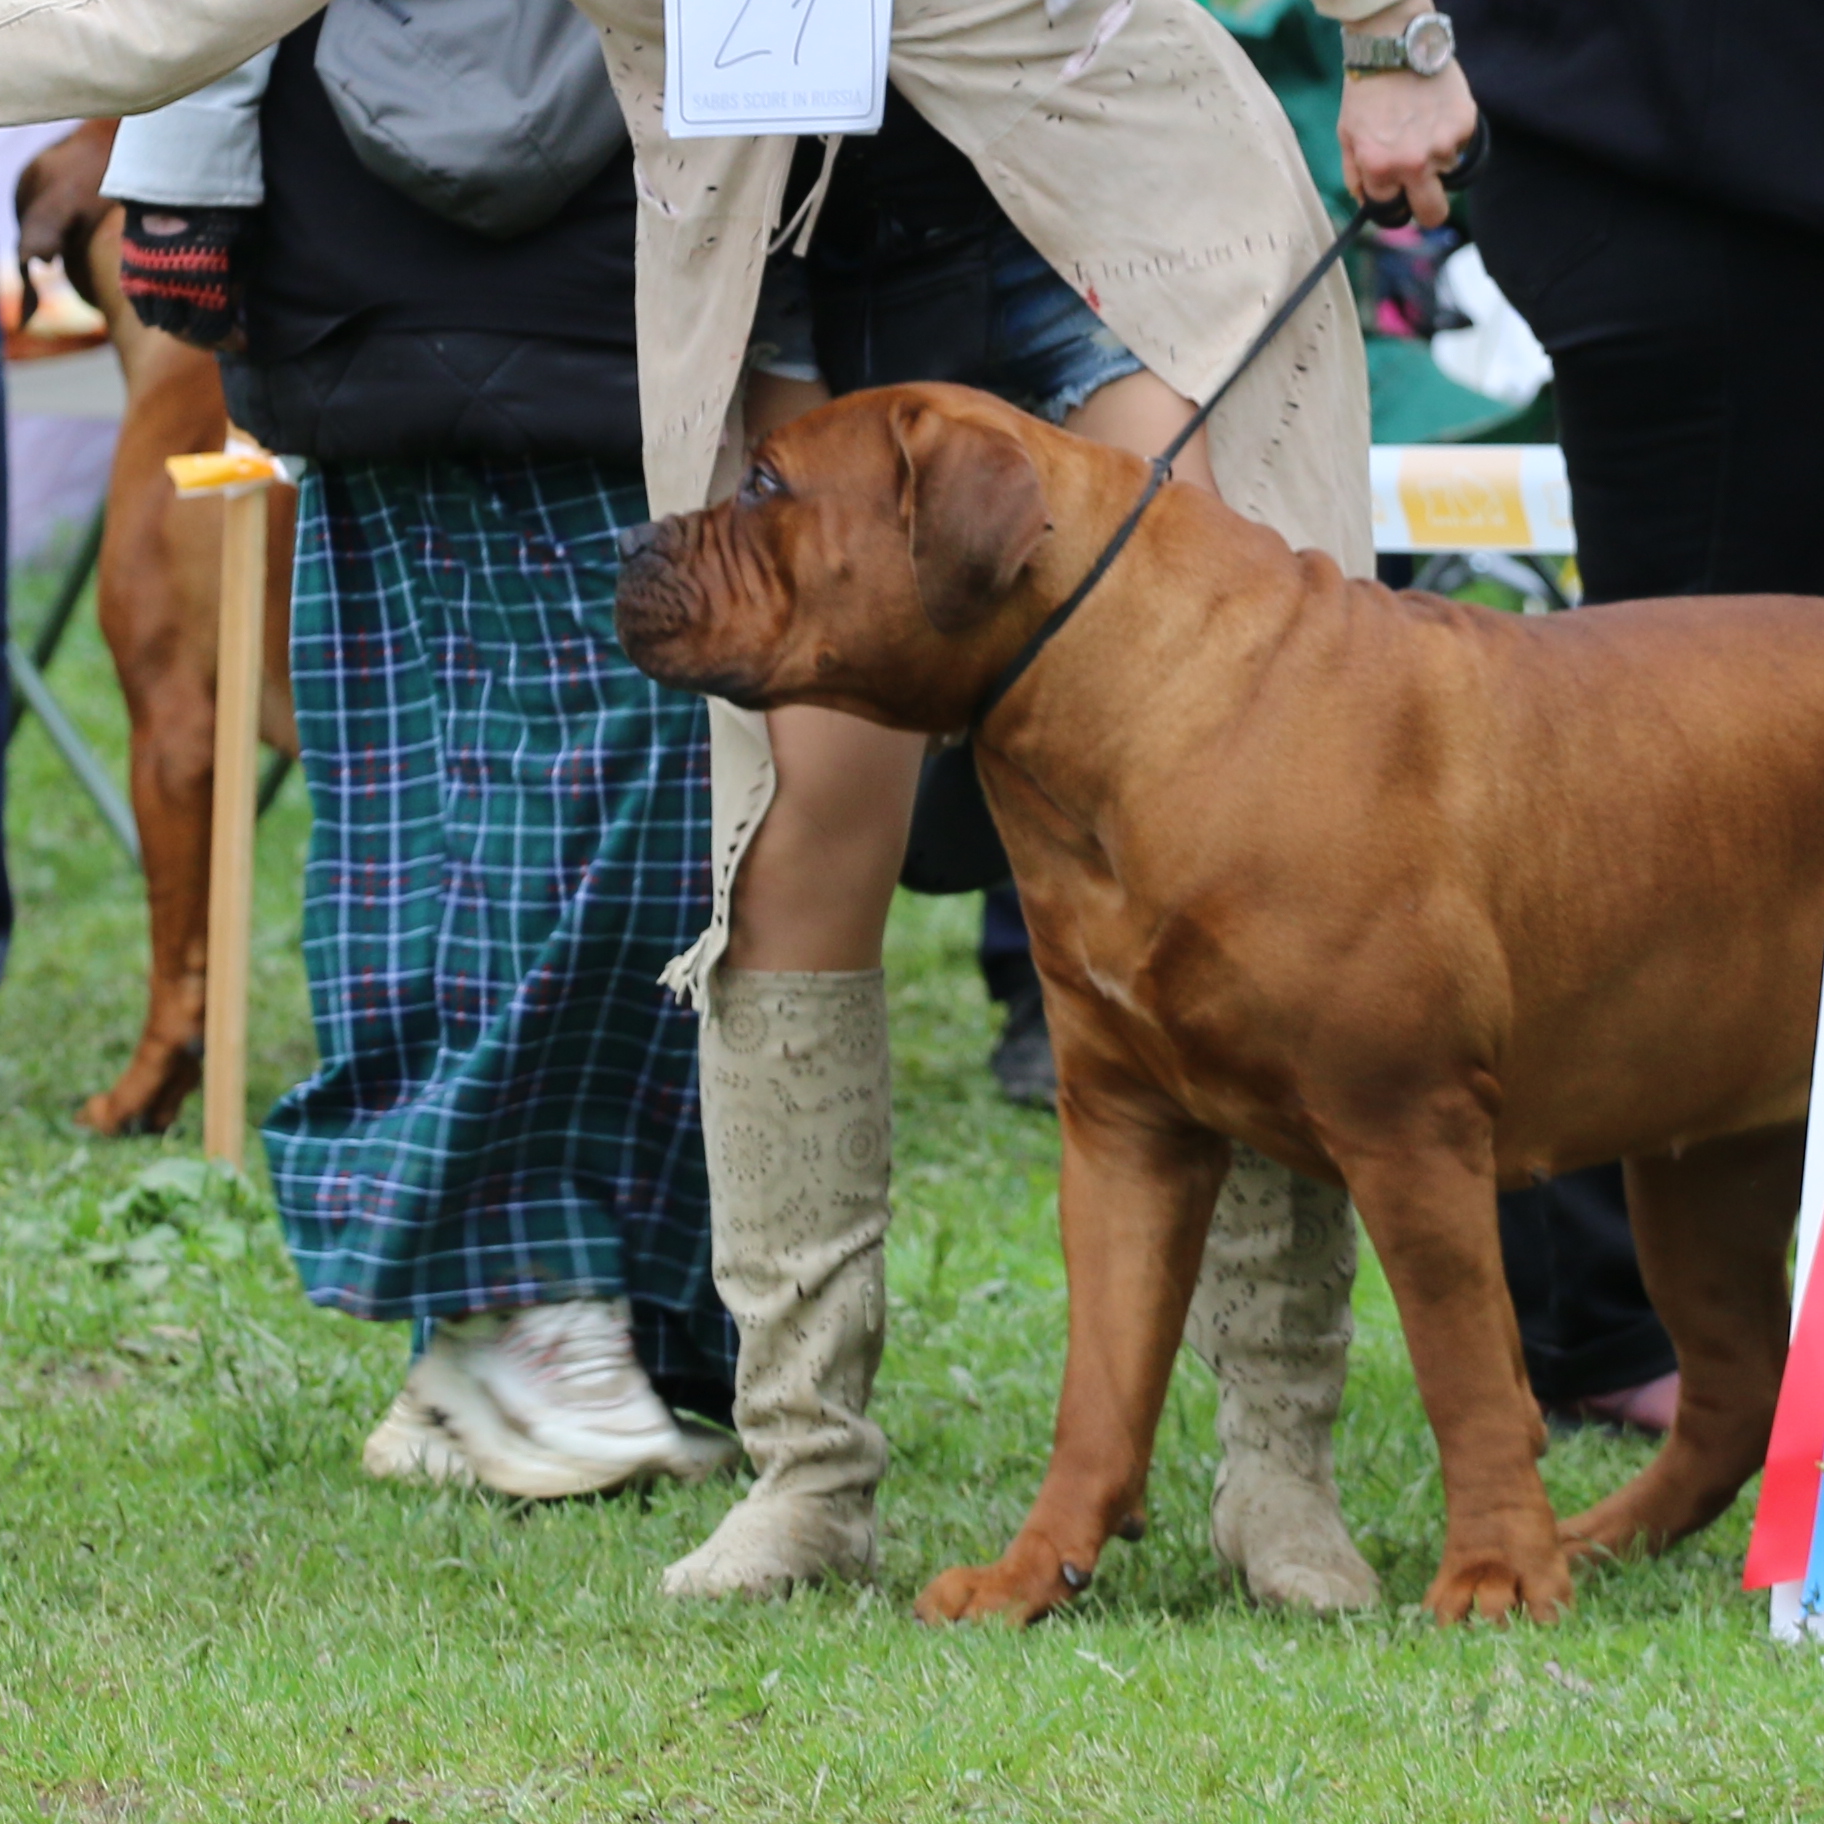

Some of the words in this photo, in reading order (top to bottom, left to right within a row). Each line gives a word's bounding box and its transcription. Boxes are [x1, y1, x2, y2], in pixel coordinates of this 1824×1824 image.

[742, 90, 788, 109] SCORE
[792, 90, 808, 107] IN
[811, 87, 863, 107] RUSSIA
